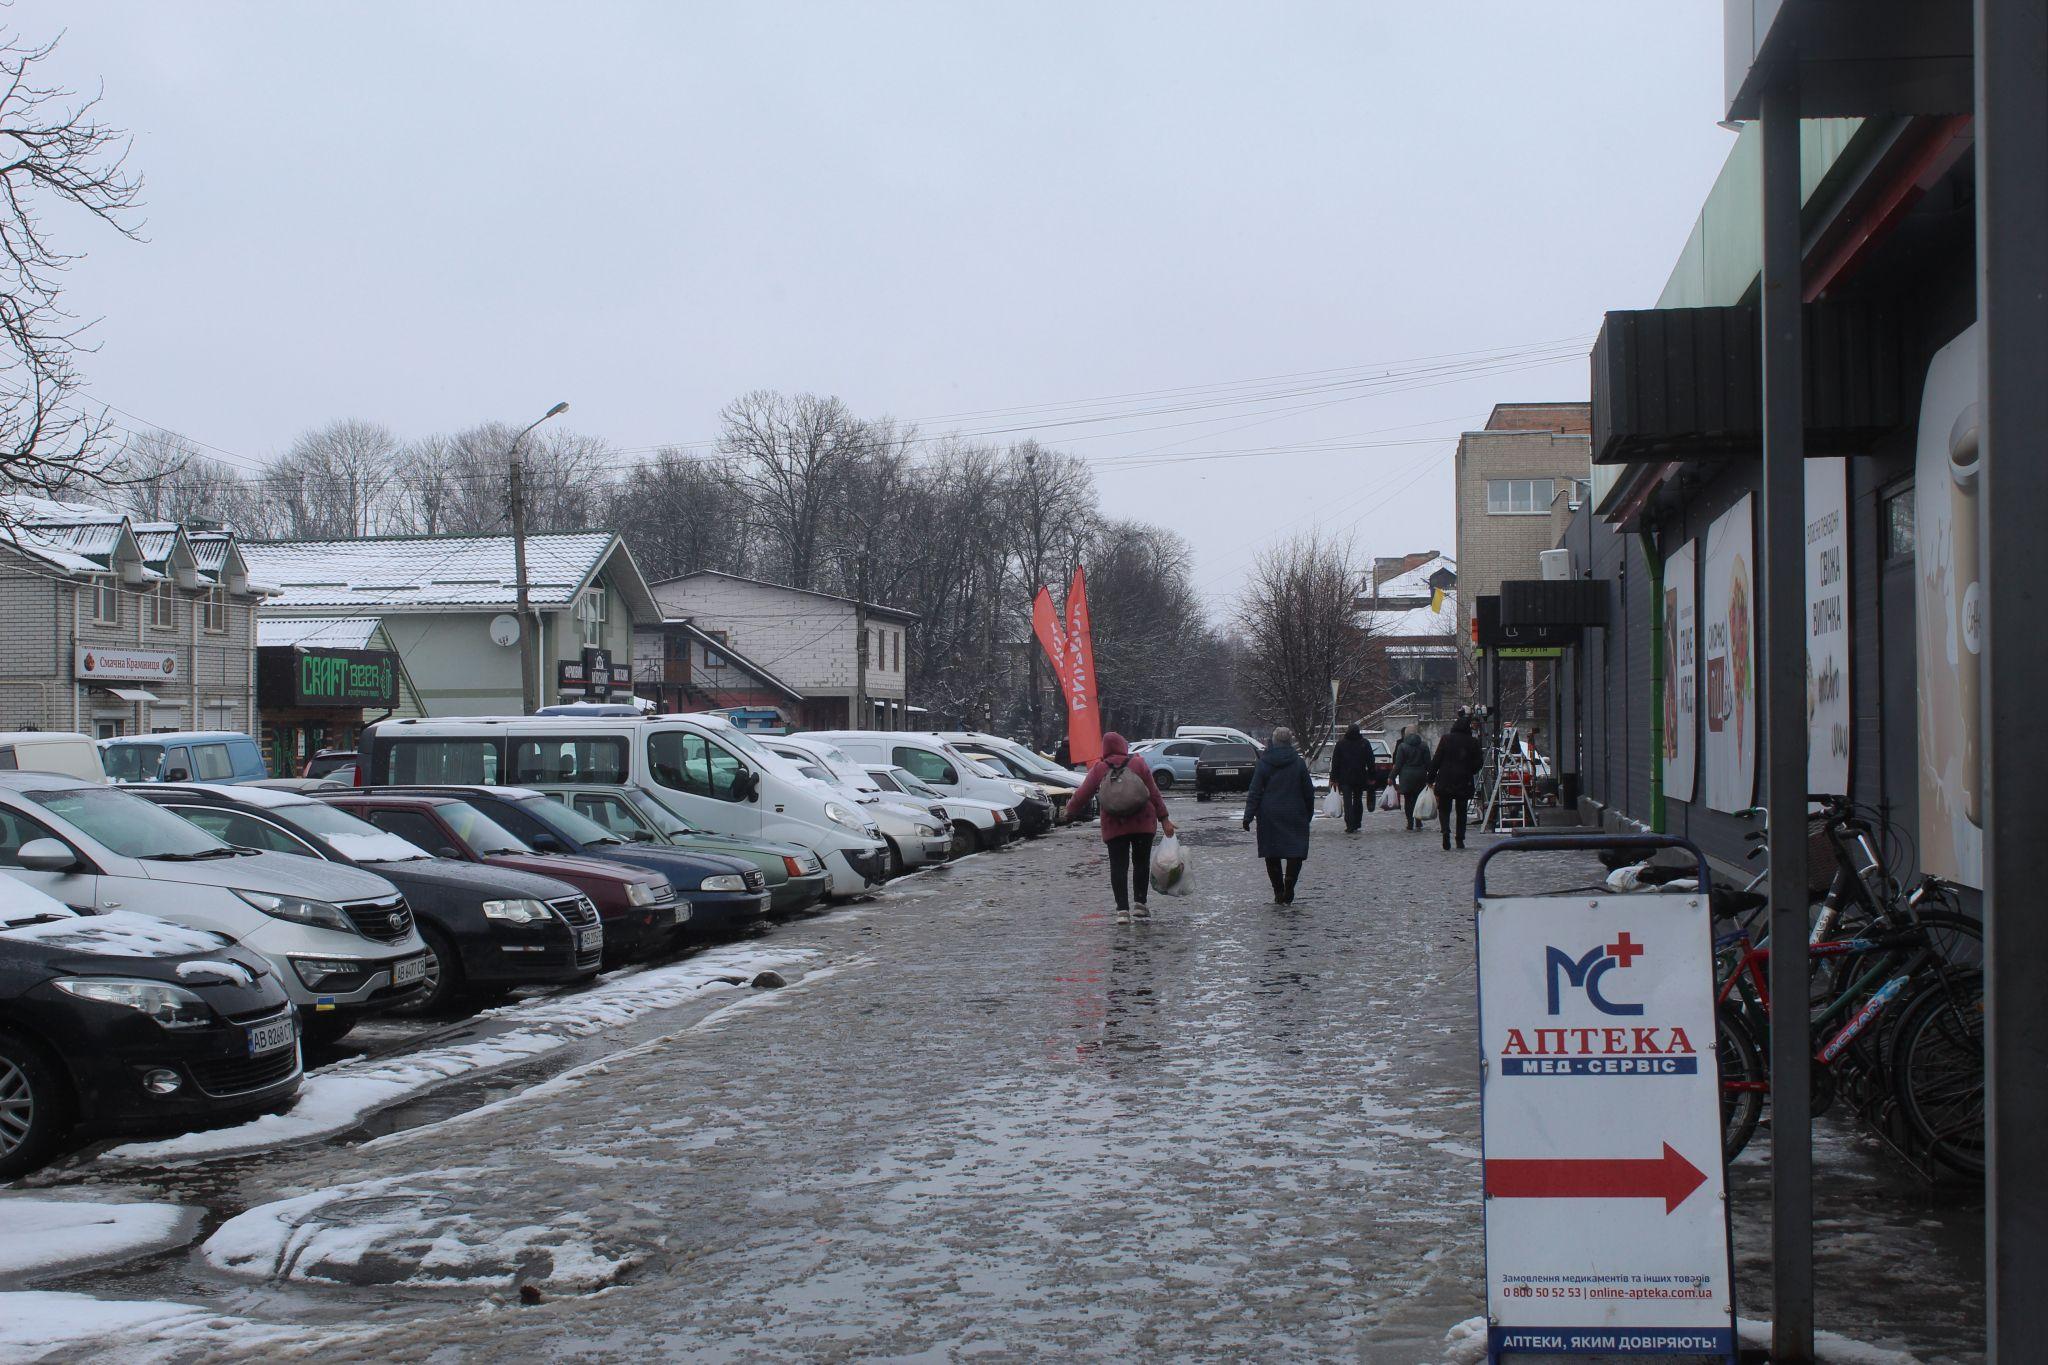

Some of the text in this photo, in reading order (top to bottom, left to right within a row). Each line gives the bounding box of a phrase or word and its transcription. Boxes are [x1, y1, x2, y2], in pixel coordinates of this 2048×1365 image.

[1820, 545, 1840, 586] СВІЖА
[1813, 595, 1841, 636] ВИПІЧКА
[100, 656, 160, 671] Смачна Крамниця
[303, 656, 379, 696] CRAFT BEER
[254, 1031, 267, 1050] AB
[268, 1025, 284, 1046] 8268
[1501, 1027, 1697, 1055] АПТЕКА
[1502, 1274, 1560, 1283] Замовлення
[1562, 1274, 1629, 1283] медикаментів
[1631, 1275, 1641, 1283] та
[1643, 1274, 1671, 1283] інших
[1503, 1287, 1713, 1299] 0 800 50 52 53 online-apteka.com.ua
[1503, 1336, 1717, 1350] АПТЕКИ, ЯКИМ ДОВІРЯЮТЬ!
